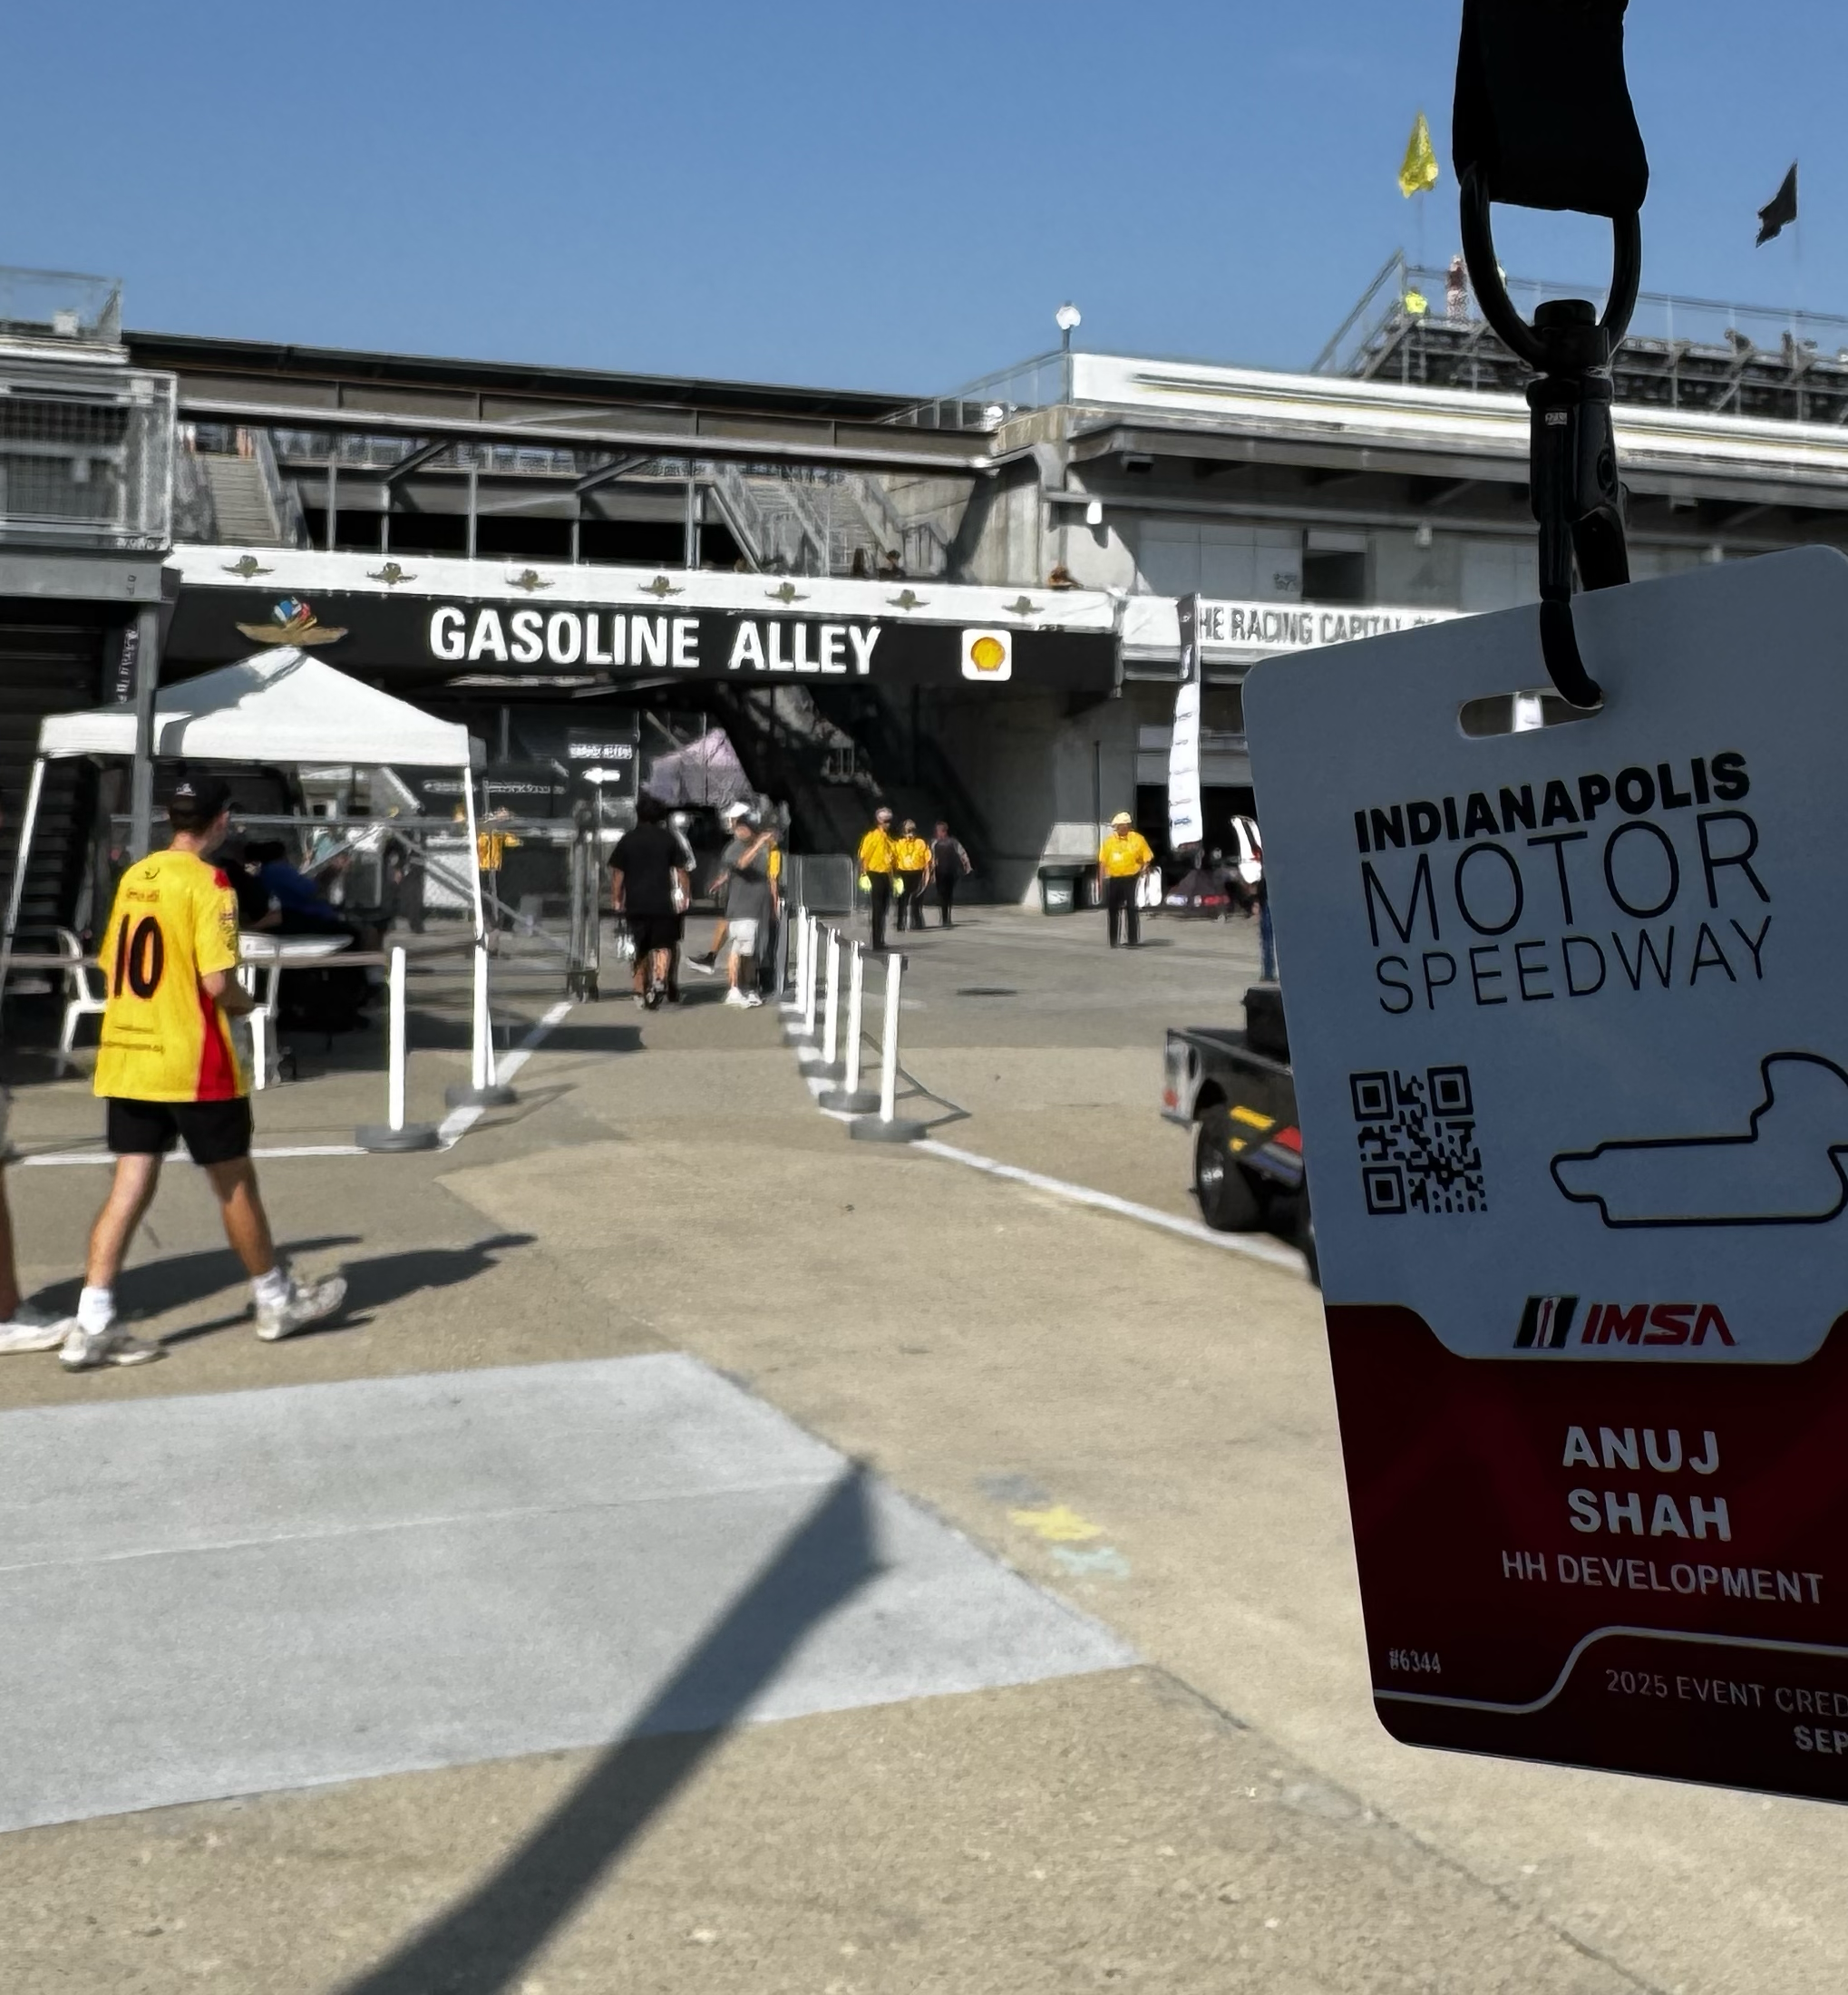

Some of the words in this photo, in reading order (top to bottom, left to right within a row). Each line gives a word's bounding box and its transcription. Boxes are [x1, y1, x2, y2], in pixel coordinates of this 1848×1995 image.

[430, 606, 700, 667] GASOLINE
[728, 620, 881, 675] ALLEY
[1200, 607, 1225, 640] HE
[1354, 752, 1750, 853] INDIANAPOLIS
[1361, 810, 1771, 947] MOTOR
[114, 914, 164, 999] 10
[1376, 915, 1772, 1014] SPEEDWAY
[1581, 1304, 1736, 1346] IMSA
[1561, 1426, 1720, 1475] ANUJ
[1568, 1489, 1732, 1542] SHAH
[1502, 1551, 1547, 1582] HH
[1558, 1554, 1824, 1604] DEVELOPMENT
[1389, 1648, 1442, 1674] #6344
[1605, 1669, 1668, 1698] 2025
[1677, 1676, 1765, 1708] EVENT
[1775, 1688, 1848, 1718] CRED
[1793, 1725, 1848, 1755] SEP
